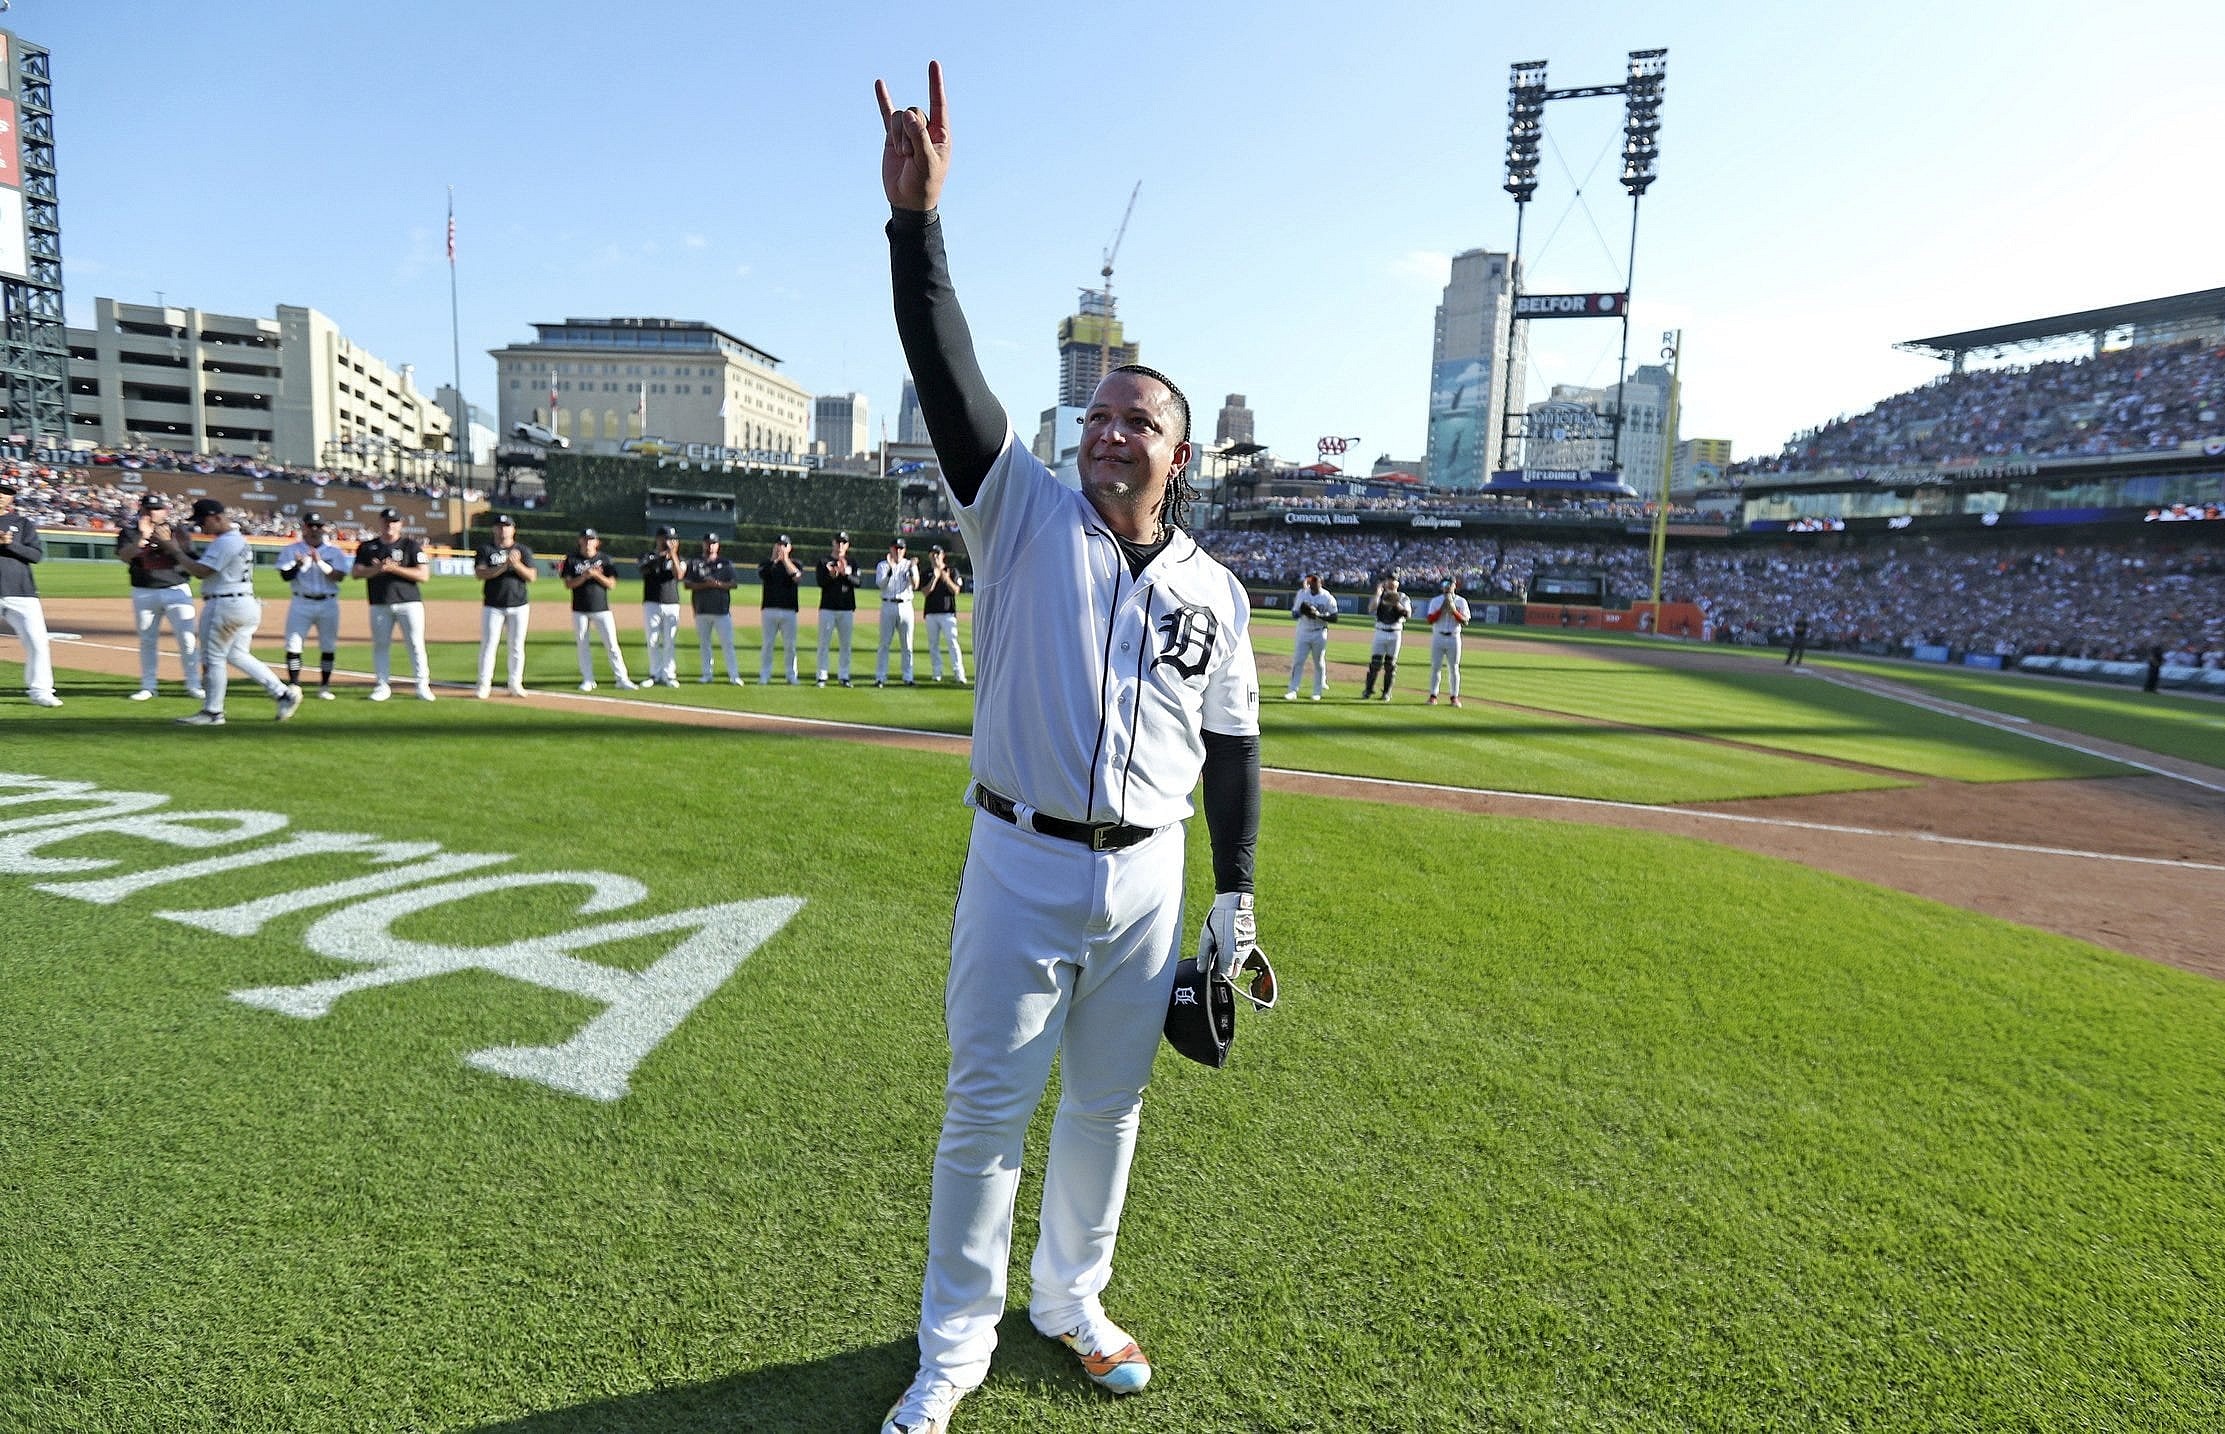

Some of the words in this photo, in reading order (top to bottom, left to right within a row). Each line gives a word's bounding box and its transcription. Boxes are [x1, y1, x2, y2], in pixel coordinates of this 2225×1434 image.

[1516, 297, 1586, 312] BELFOR
[1319, 436, 1346, 454] AAA
[687, 443, 826, 470] CHEVROLET
[1333, 514, 1360, 525] Bank
[1149, 586, 1219, 681] D
